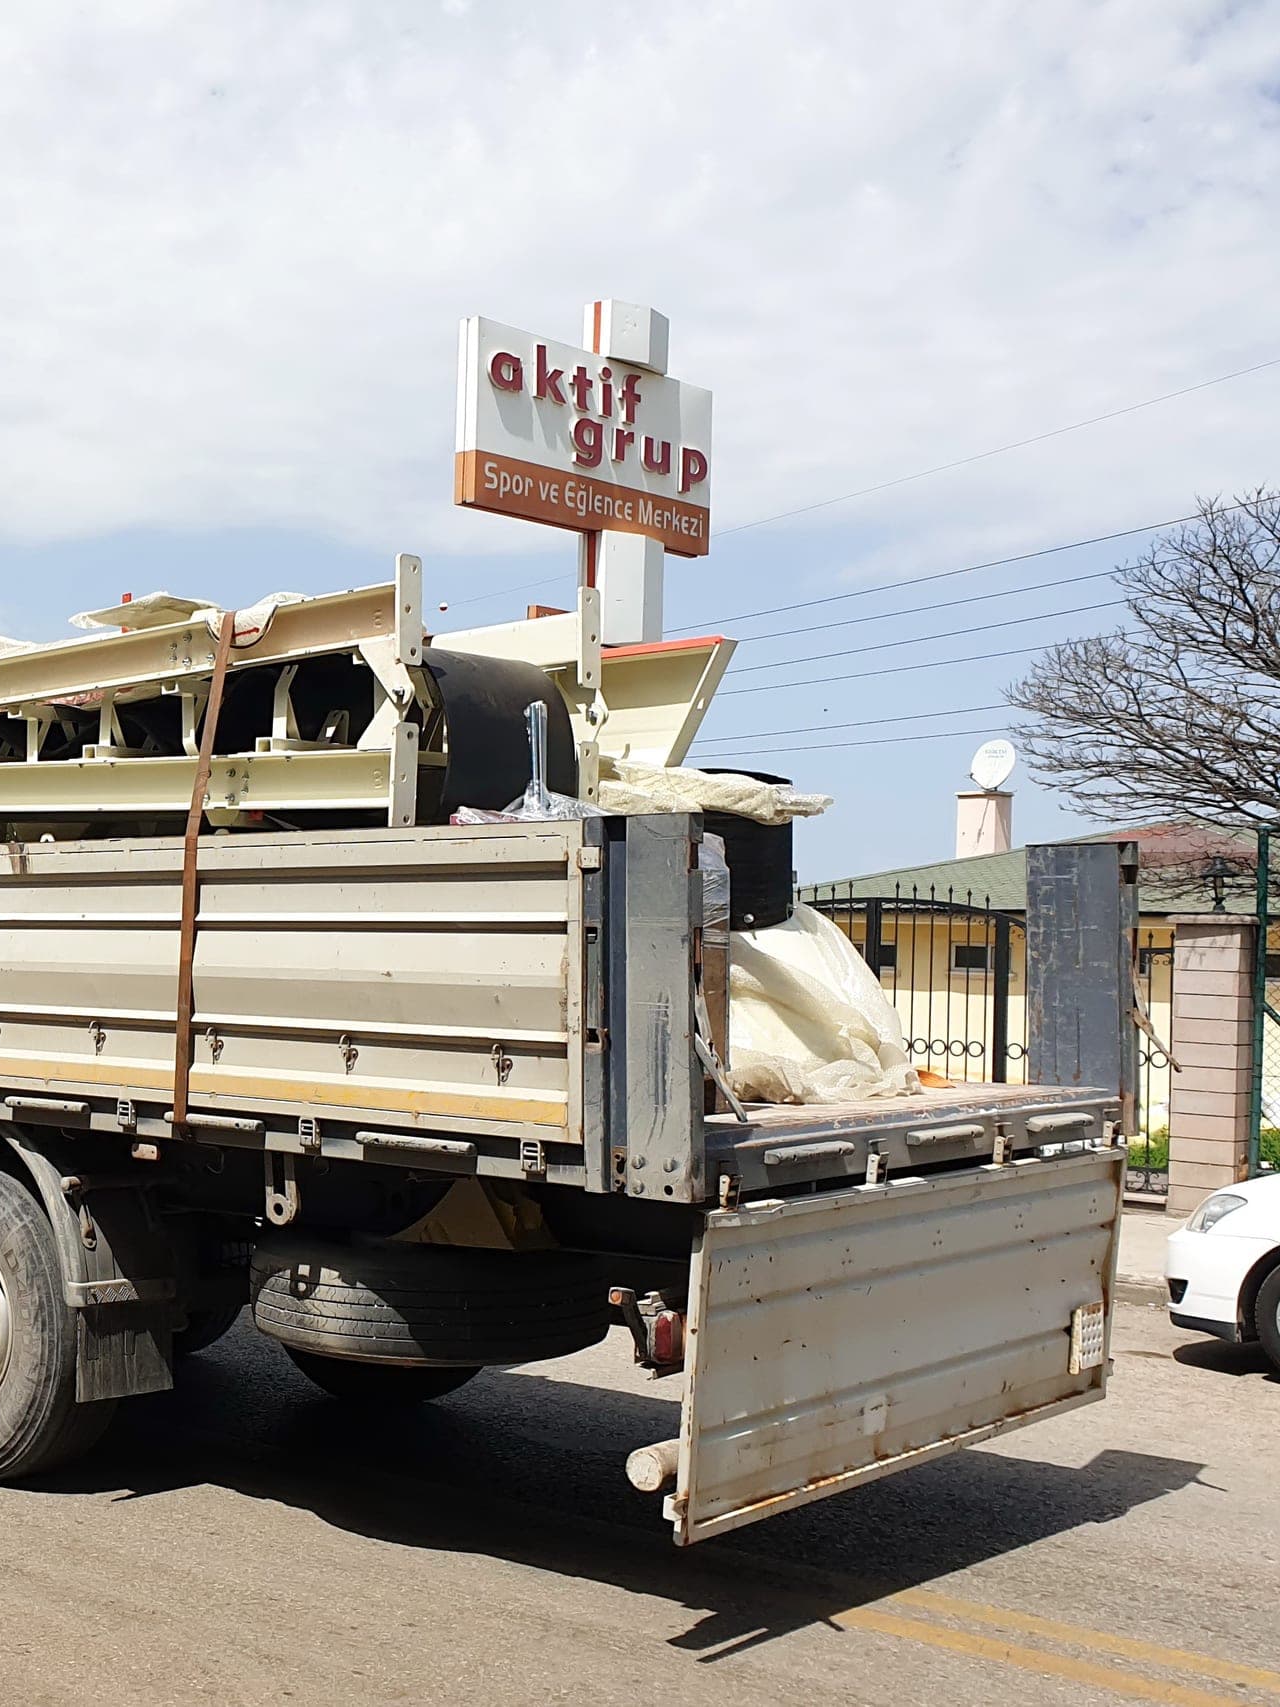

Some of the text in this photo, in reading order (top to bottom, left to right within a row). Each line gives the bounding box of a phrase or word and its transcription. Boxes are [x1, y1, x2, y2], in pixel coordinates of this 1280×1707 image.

[488, 344, 642, 425] aktif
[571, 418, 708, 494] grup
[483, 460, 704, 539] Spor ve Eğlence Merkezi
